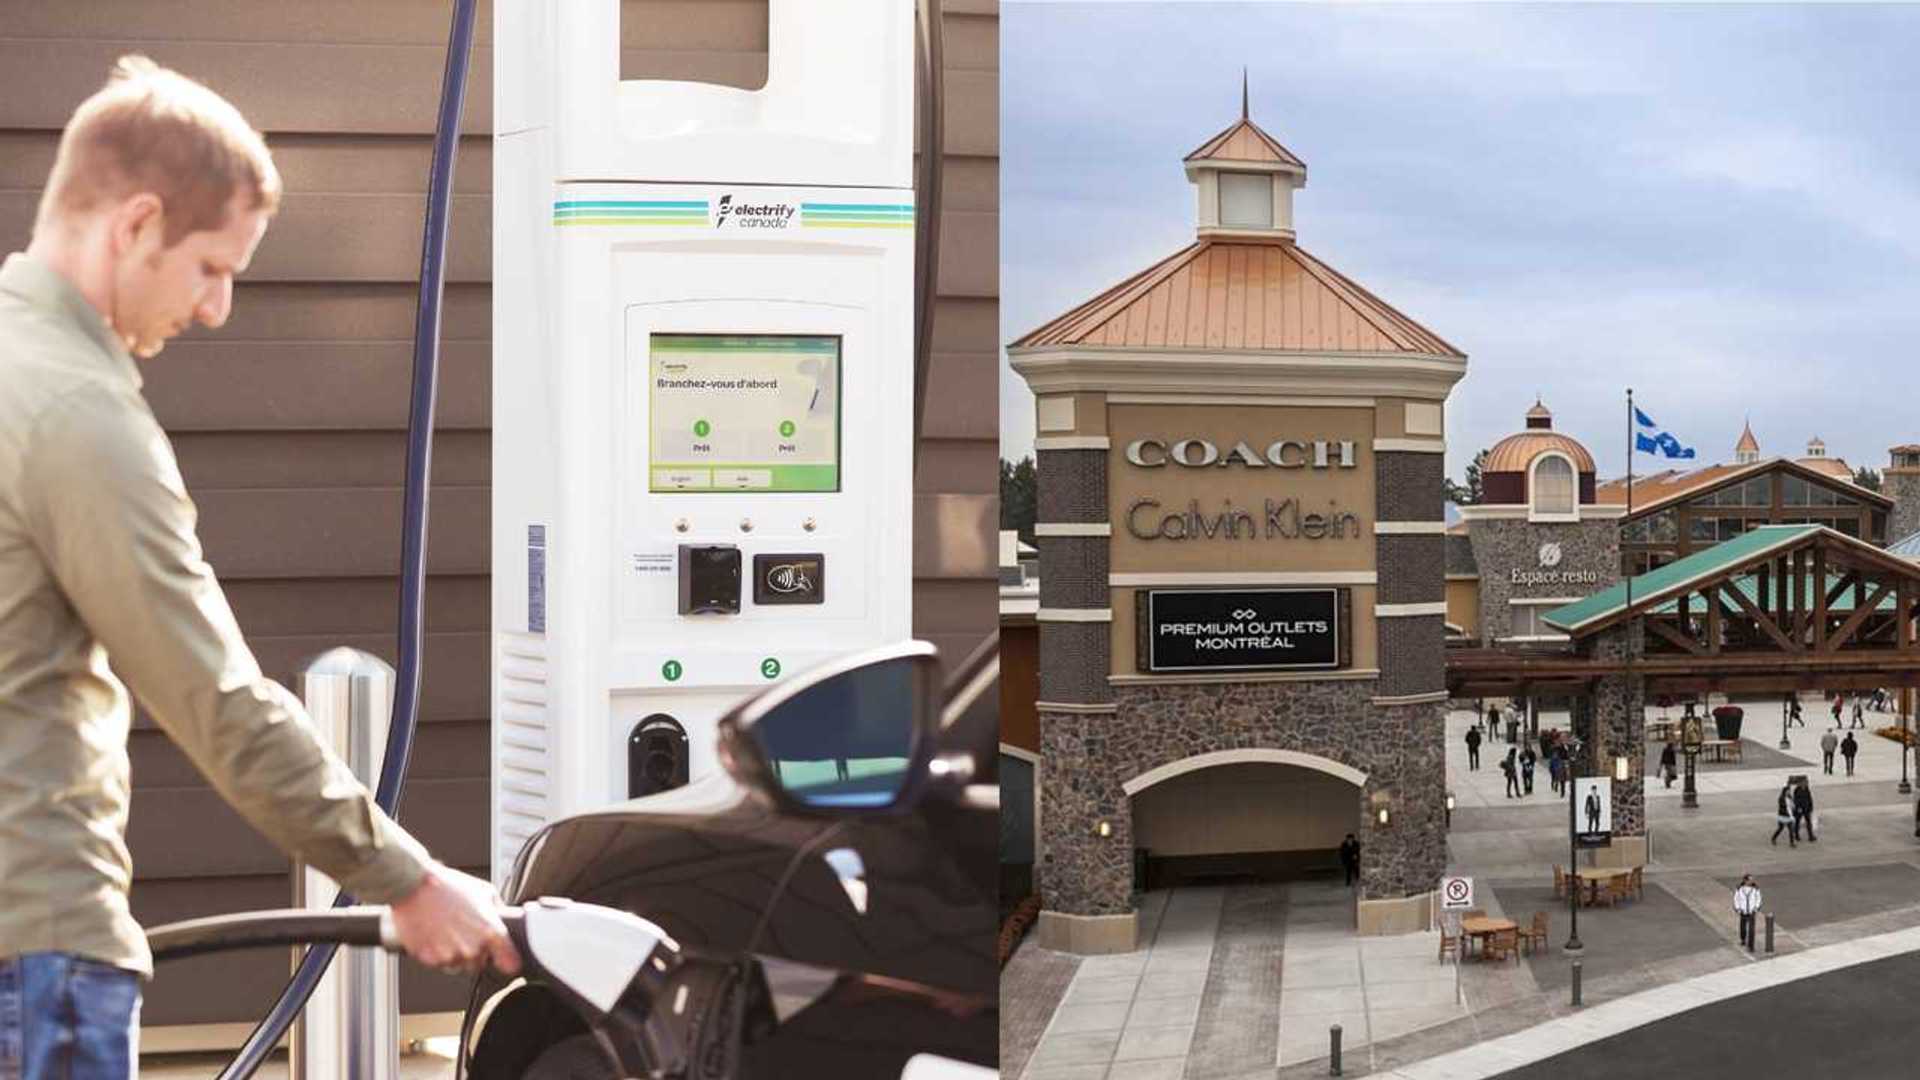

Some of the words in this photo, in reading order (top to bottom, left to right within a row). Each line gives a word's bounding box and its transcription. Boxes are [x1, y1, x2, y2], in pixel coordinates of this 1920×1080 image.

[735, 203, 795, 218] electrify
[739, 217, 788, 229] canada
[657, 379, 735, 389] Branchez-vous
[1125, 439, 1357, 469] COACH
[1127, 499, 1257, 540] Calvin
[1264, 499, 1360, 540] Klein
[1511, 568, 1558, 587] Espace
[1562, 568, 1597, 584] resto
[1160, 623, 1244, 636] PREMIUM
[1248, 621, 1328, 634] OUTLETS
[1195, 633, 1295, 650] MONTRÉAL
